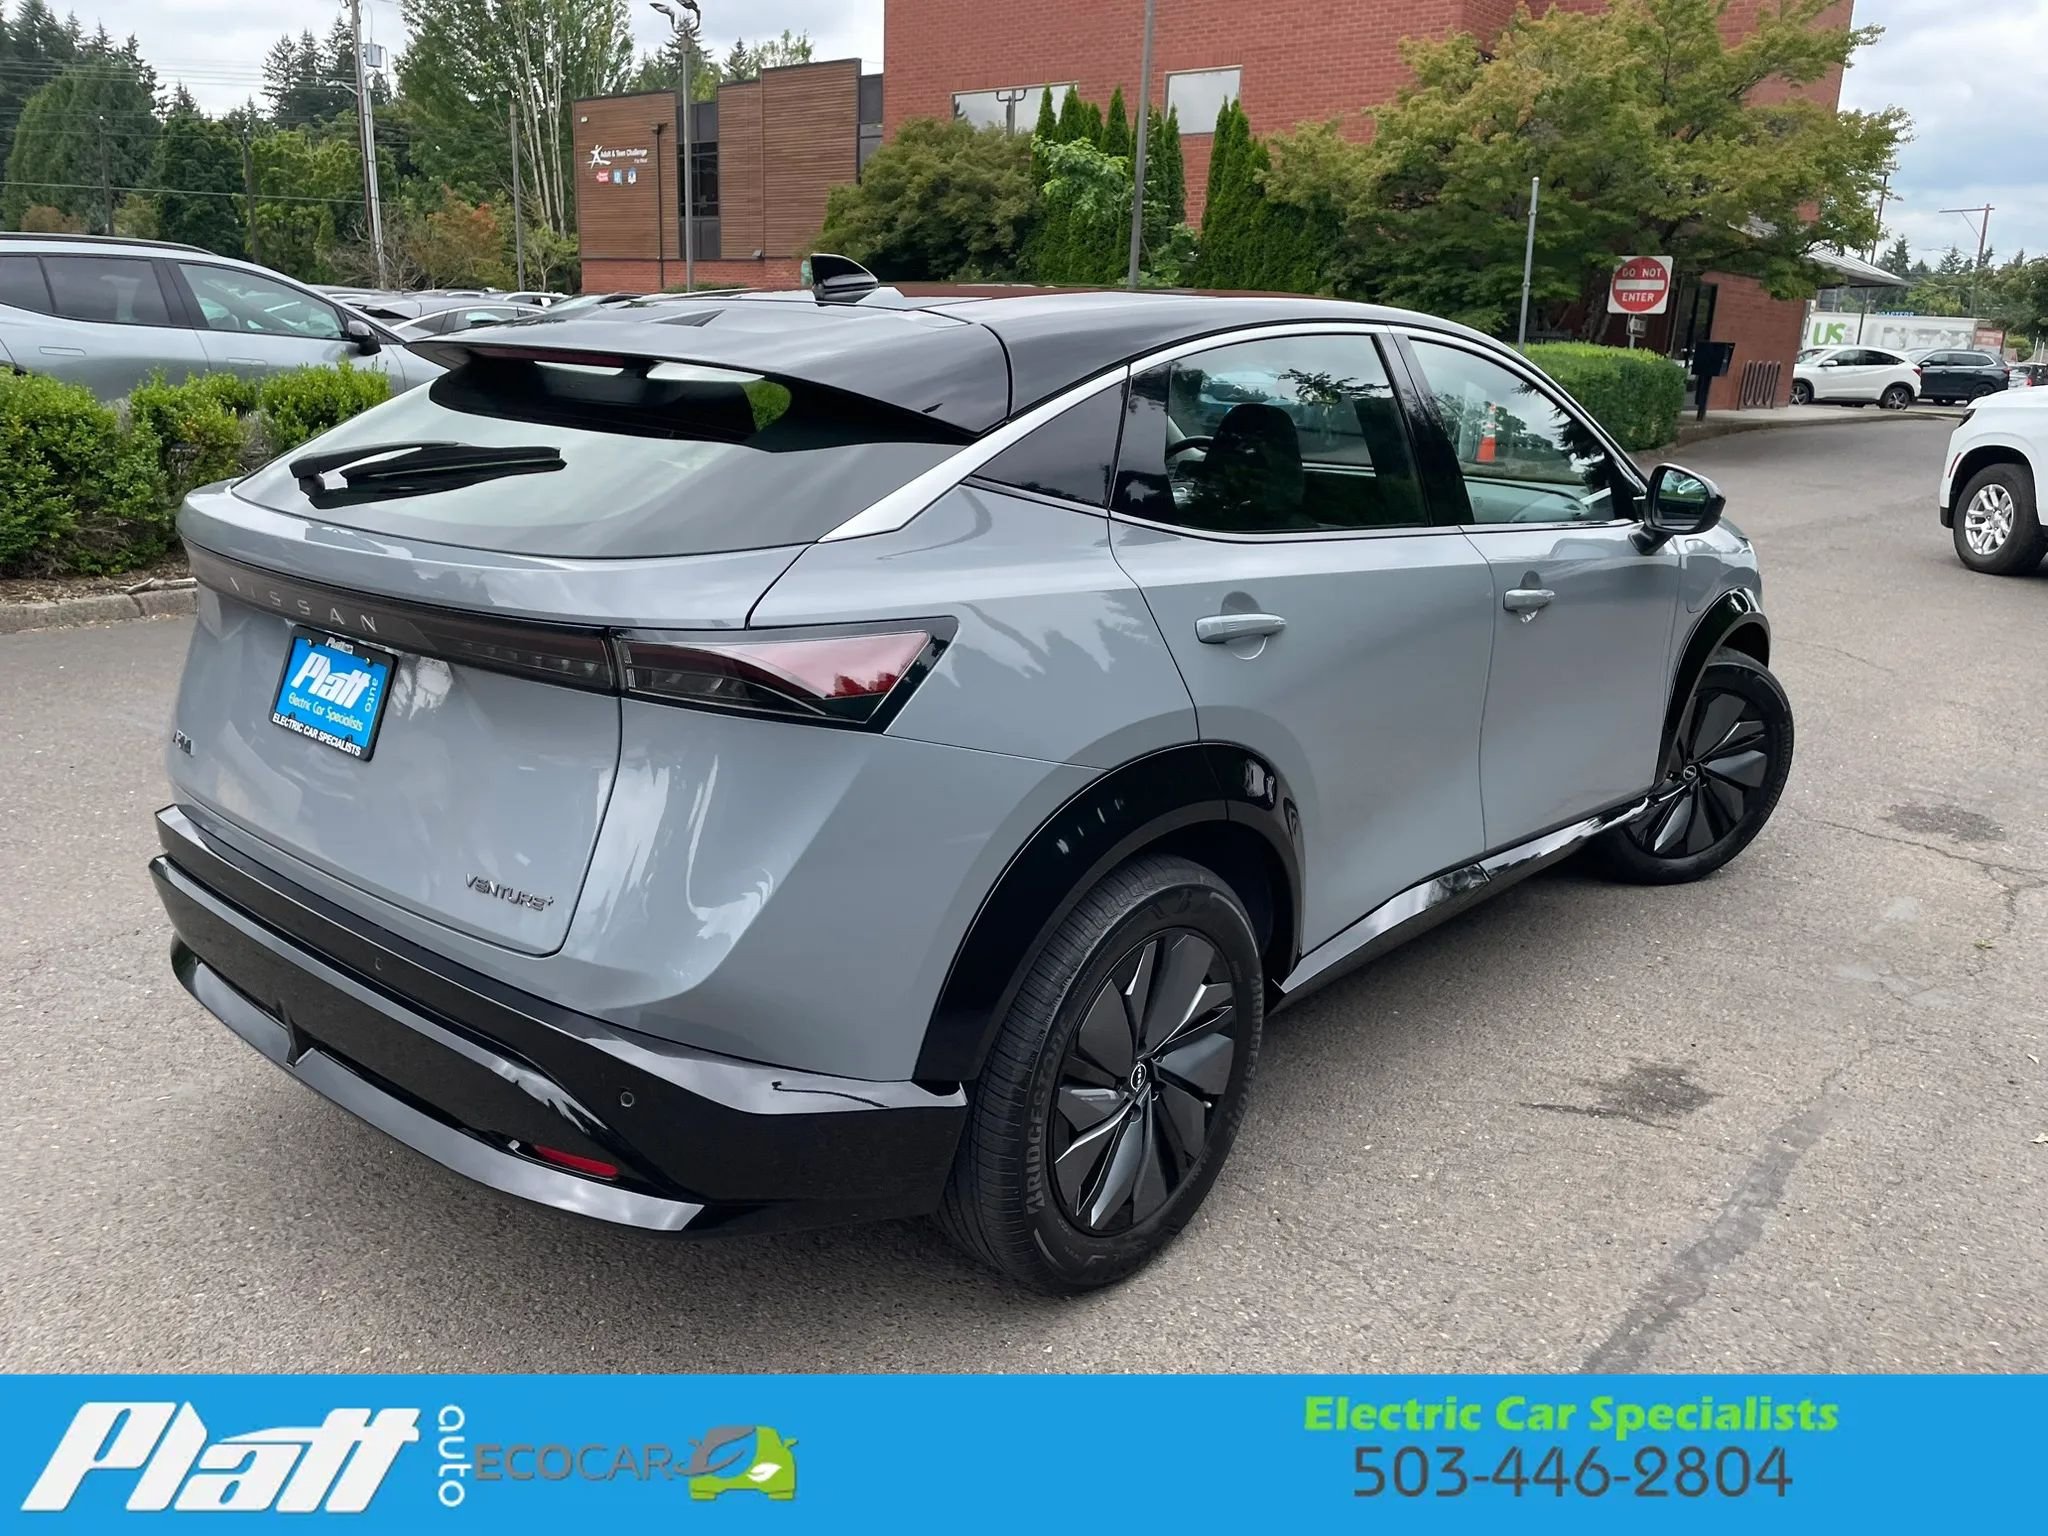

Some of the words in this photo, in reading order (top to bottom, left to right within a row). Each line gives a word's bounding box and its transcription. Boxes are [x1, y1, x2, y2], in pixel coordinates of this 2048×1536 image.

[1622, 267, 1636, 277] DO
[1642, 267, 1662, 278] NOT
[1622, 292, 1655, 302] ENTER
[288, 692, 312, 712] Electric
[312, 701, 325, 716] Car
[326, 706, 364, 732] Specialists
[364, 677, 379, 713] auto
[272, 712, 305, 733] ELECTRIC
[303, 726, 319, 740] CAR
[317, 730, 362, 757] SPECIALISTS
